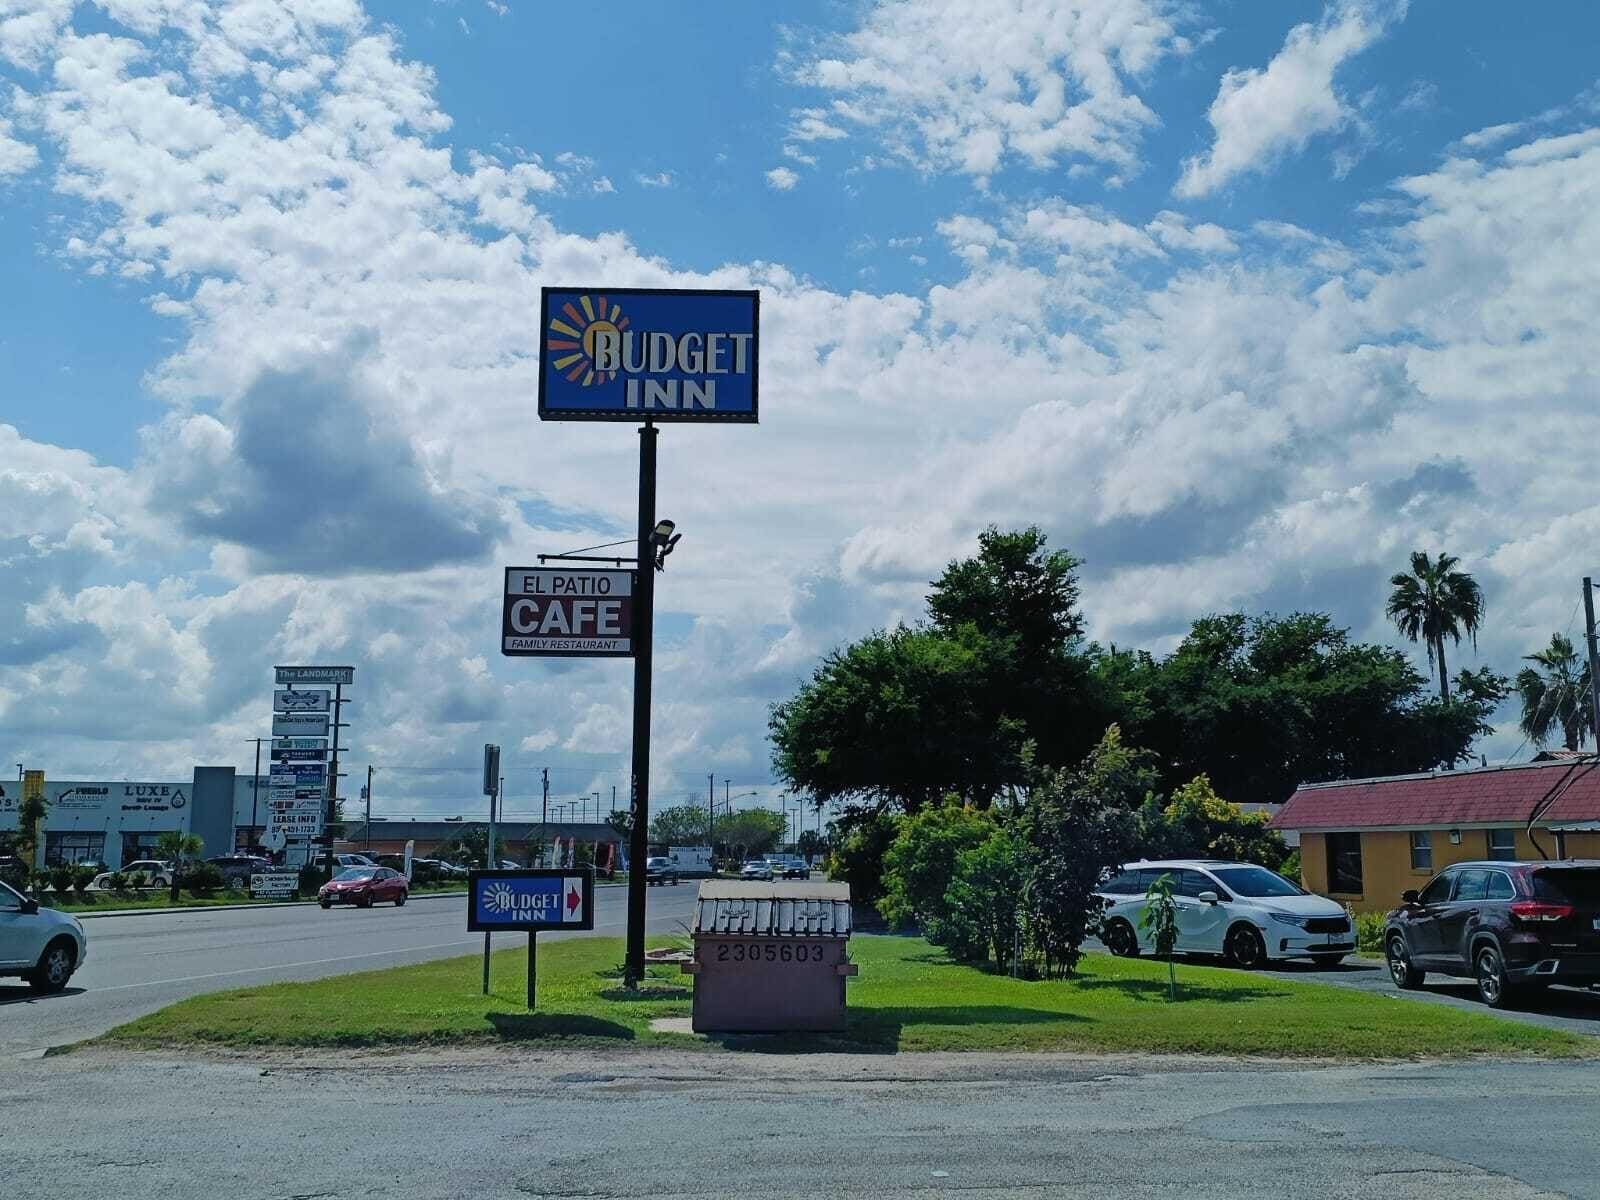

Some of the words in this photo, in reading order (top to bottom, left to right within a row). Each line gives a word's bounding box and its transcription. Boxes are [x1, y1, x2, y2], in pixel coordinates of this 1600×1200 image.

[595, 329, 753, 374] BUDGET
[626, 379, 716, 409] INN
[523, 576, 546, 594] EL
[552, 576, 611, 595] PATIO
[510, 598, 622, 635] CAFE
[511, 639, 548, 649] FAMILY
[550, 640, 618, 650] RESTAURANT
[280, 670, 296, 678] The
[297, 670, 348, 679] LANDMARK
[124, 785, 170, 796] LUXE
[273, 815, 296, 824] LEASE
[297, 815, 317, 824] INFO
[500, 893, 561, 909] BUDGET
[512, 909, 546, 921] INN
[717, 944, 824, 962] 2305603
